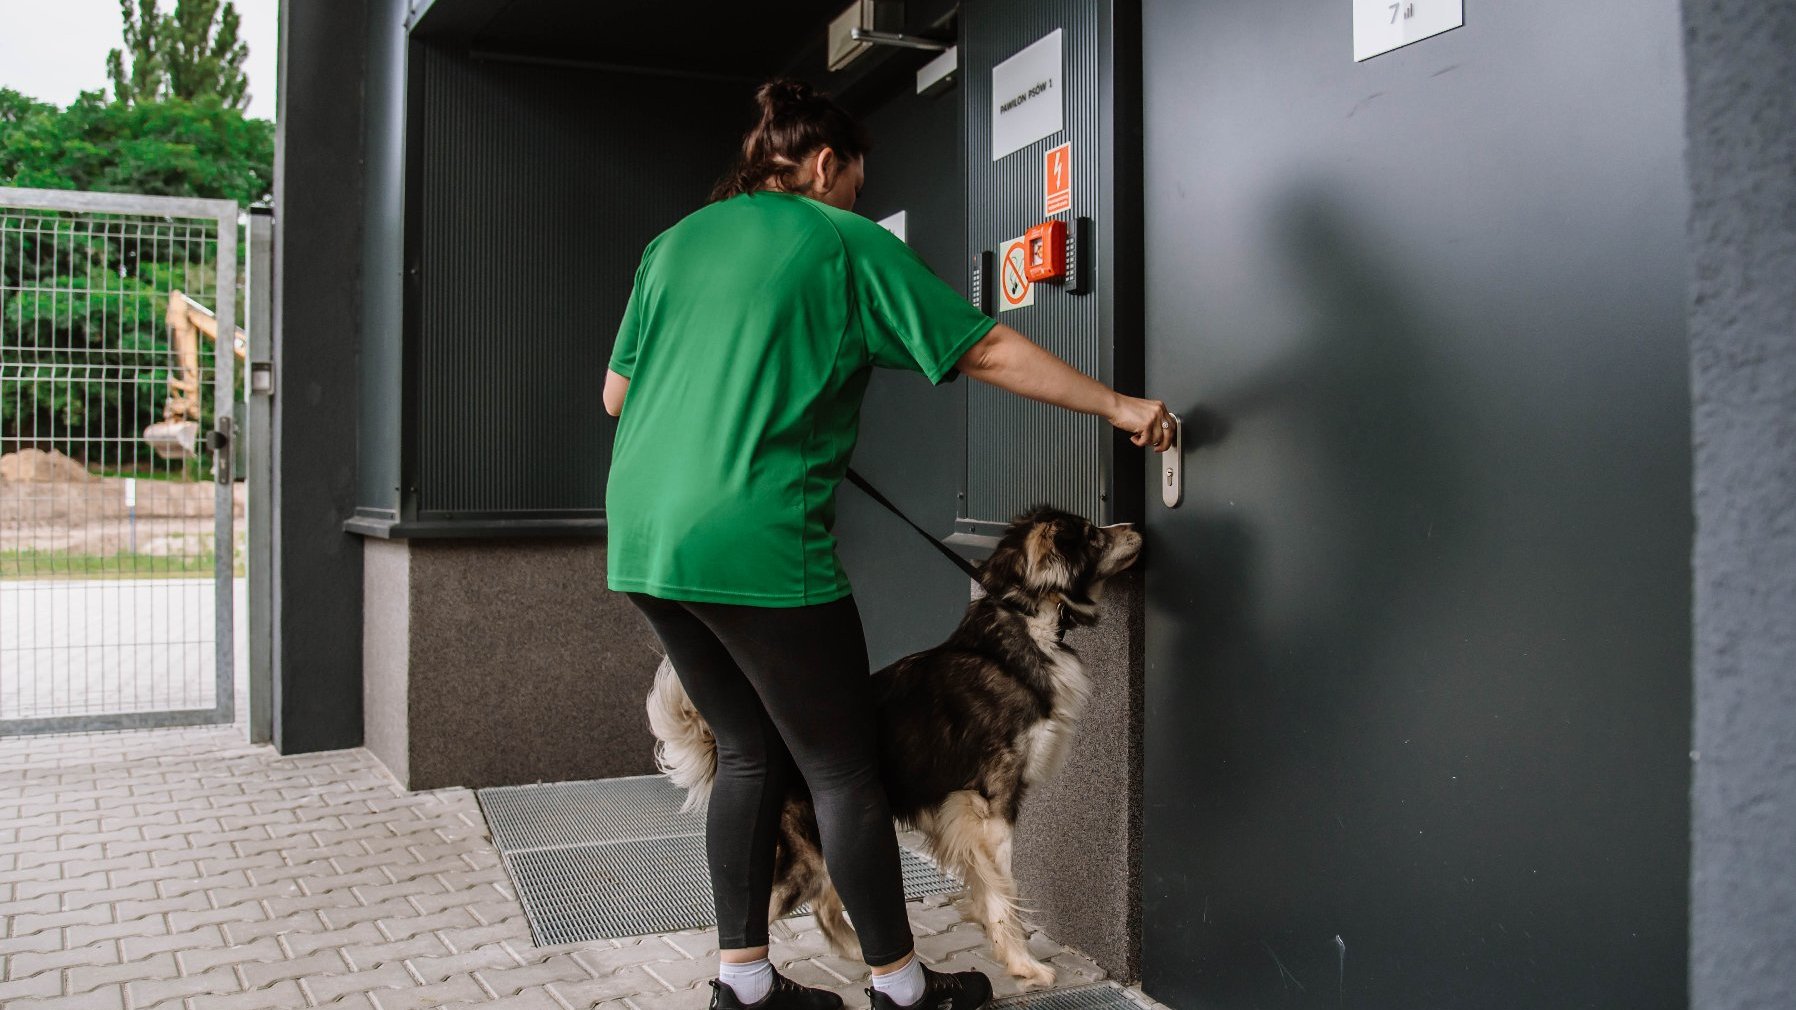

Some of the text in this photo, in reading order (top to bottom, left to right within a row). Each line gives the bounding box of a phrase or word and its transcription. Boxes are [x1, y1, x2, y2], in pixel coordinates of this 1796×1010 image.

[1389, 2, 1400, 24] 7
[1000, 78, 1053, 115] PAWILON PSÓW 1
